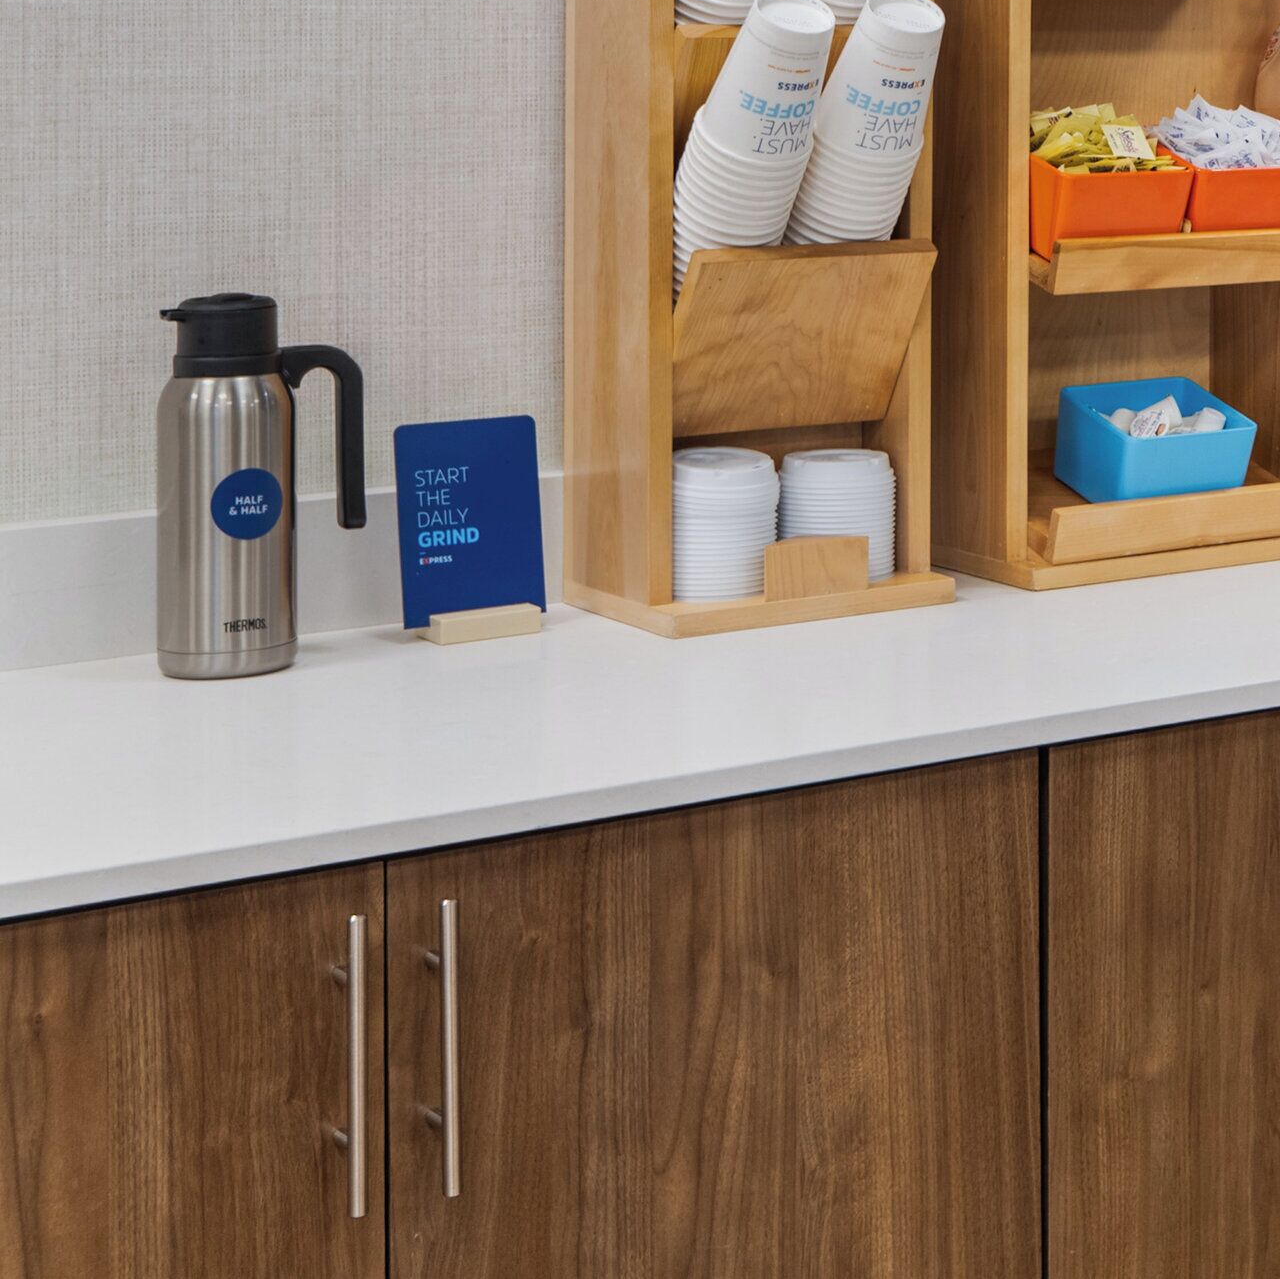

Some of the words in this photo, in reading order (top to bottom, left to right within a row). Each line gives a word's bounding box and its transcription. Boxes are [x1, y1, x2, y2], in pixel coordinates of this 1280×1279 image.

[777, 79, 820, 92] EXPRESS
[881, 78, 926, 90] EXPRESS
[740, 90, 816, 119] COFFEE.
[846, 85, 922, 116] COFFEE.
[760, 116, 811, 136] HAVE.
[864, 113, 918, 134] HAVE.
[752, 135, 808, 155] MUST.
[855, 130, 914, 151] MUST.
[414, 467, 469, 488] START
[234, 495, 264, 506] HALF
[416, 489, 451, 508] THE
[228, 507, 238, 516] &
[240, 505, 269, 515] HALF
[418, 507, 469, 529] DAILY
[418, 527, 480, 548] GRIND
[419, 555, 453, 566] EXPRESS
